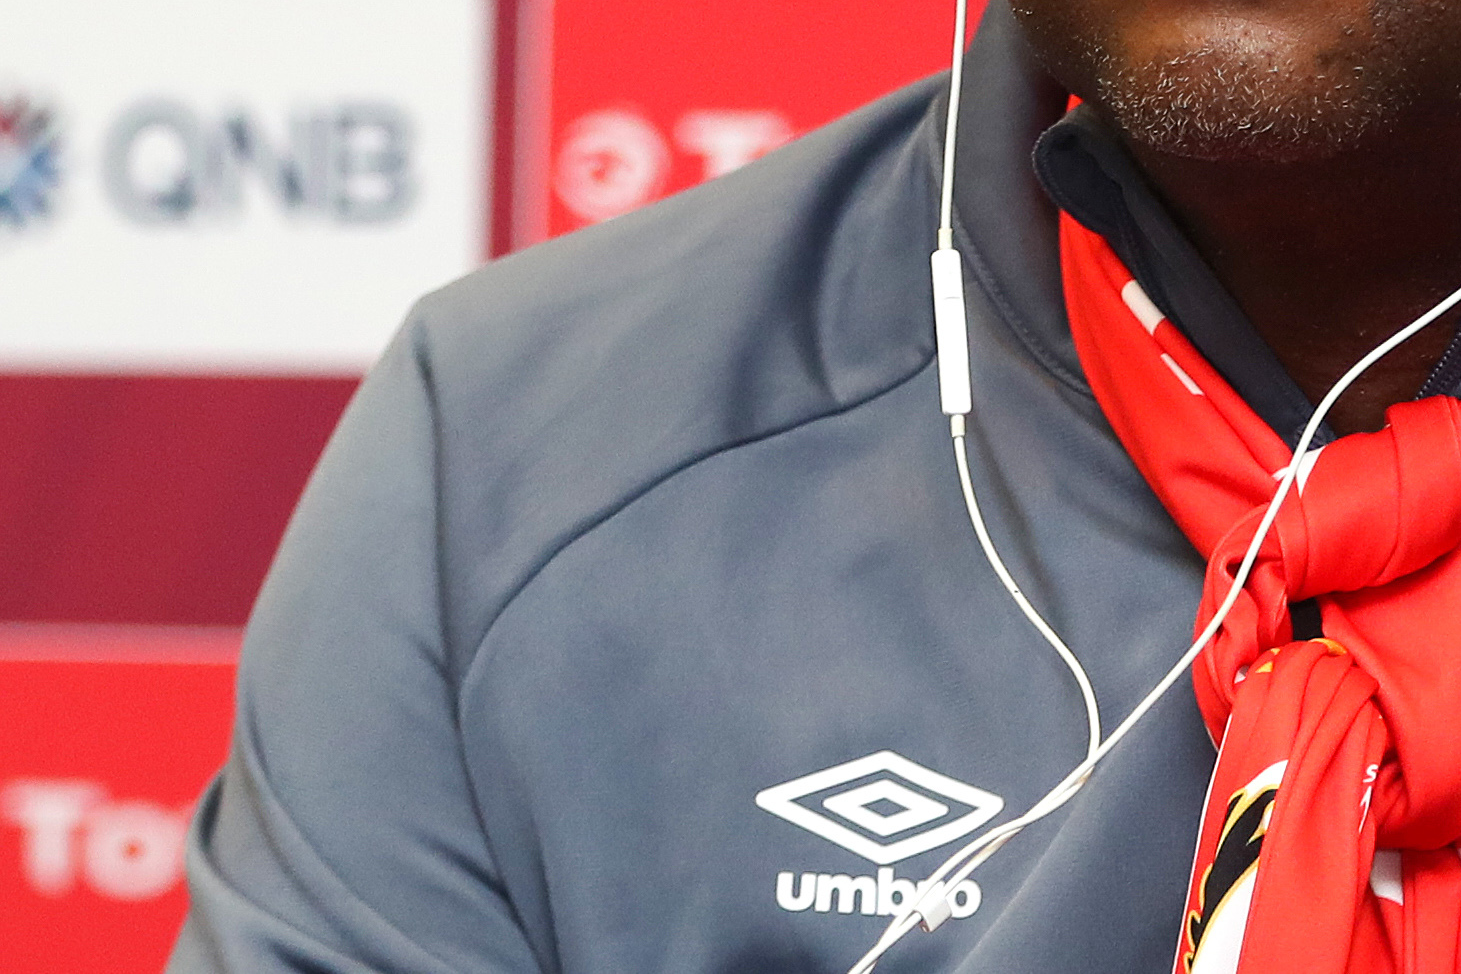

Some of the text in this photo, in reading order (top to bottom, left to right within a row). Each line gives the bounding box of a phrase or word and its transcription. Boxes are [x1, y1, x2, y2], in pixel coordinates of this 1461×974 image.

[103, 96, 420, 226] QNB
[0, 778, 190, 902] TO
[775, 865, 983, 920] umbo
